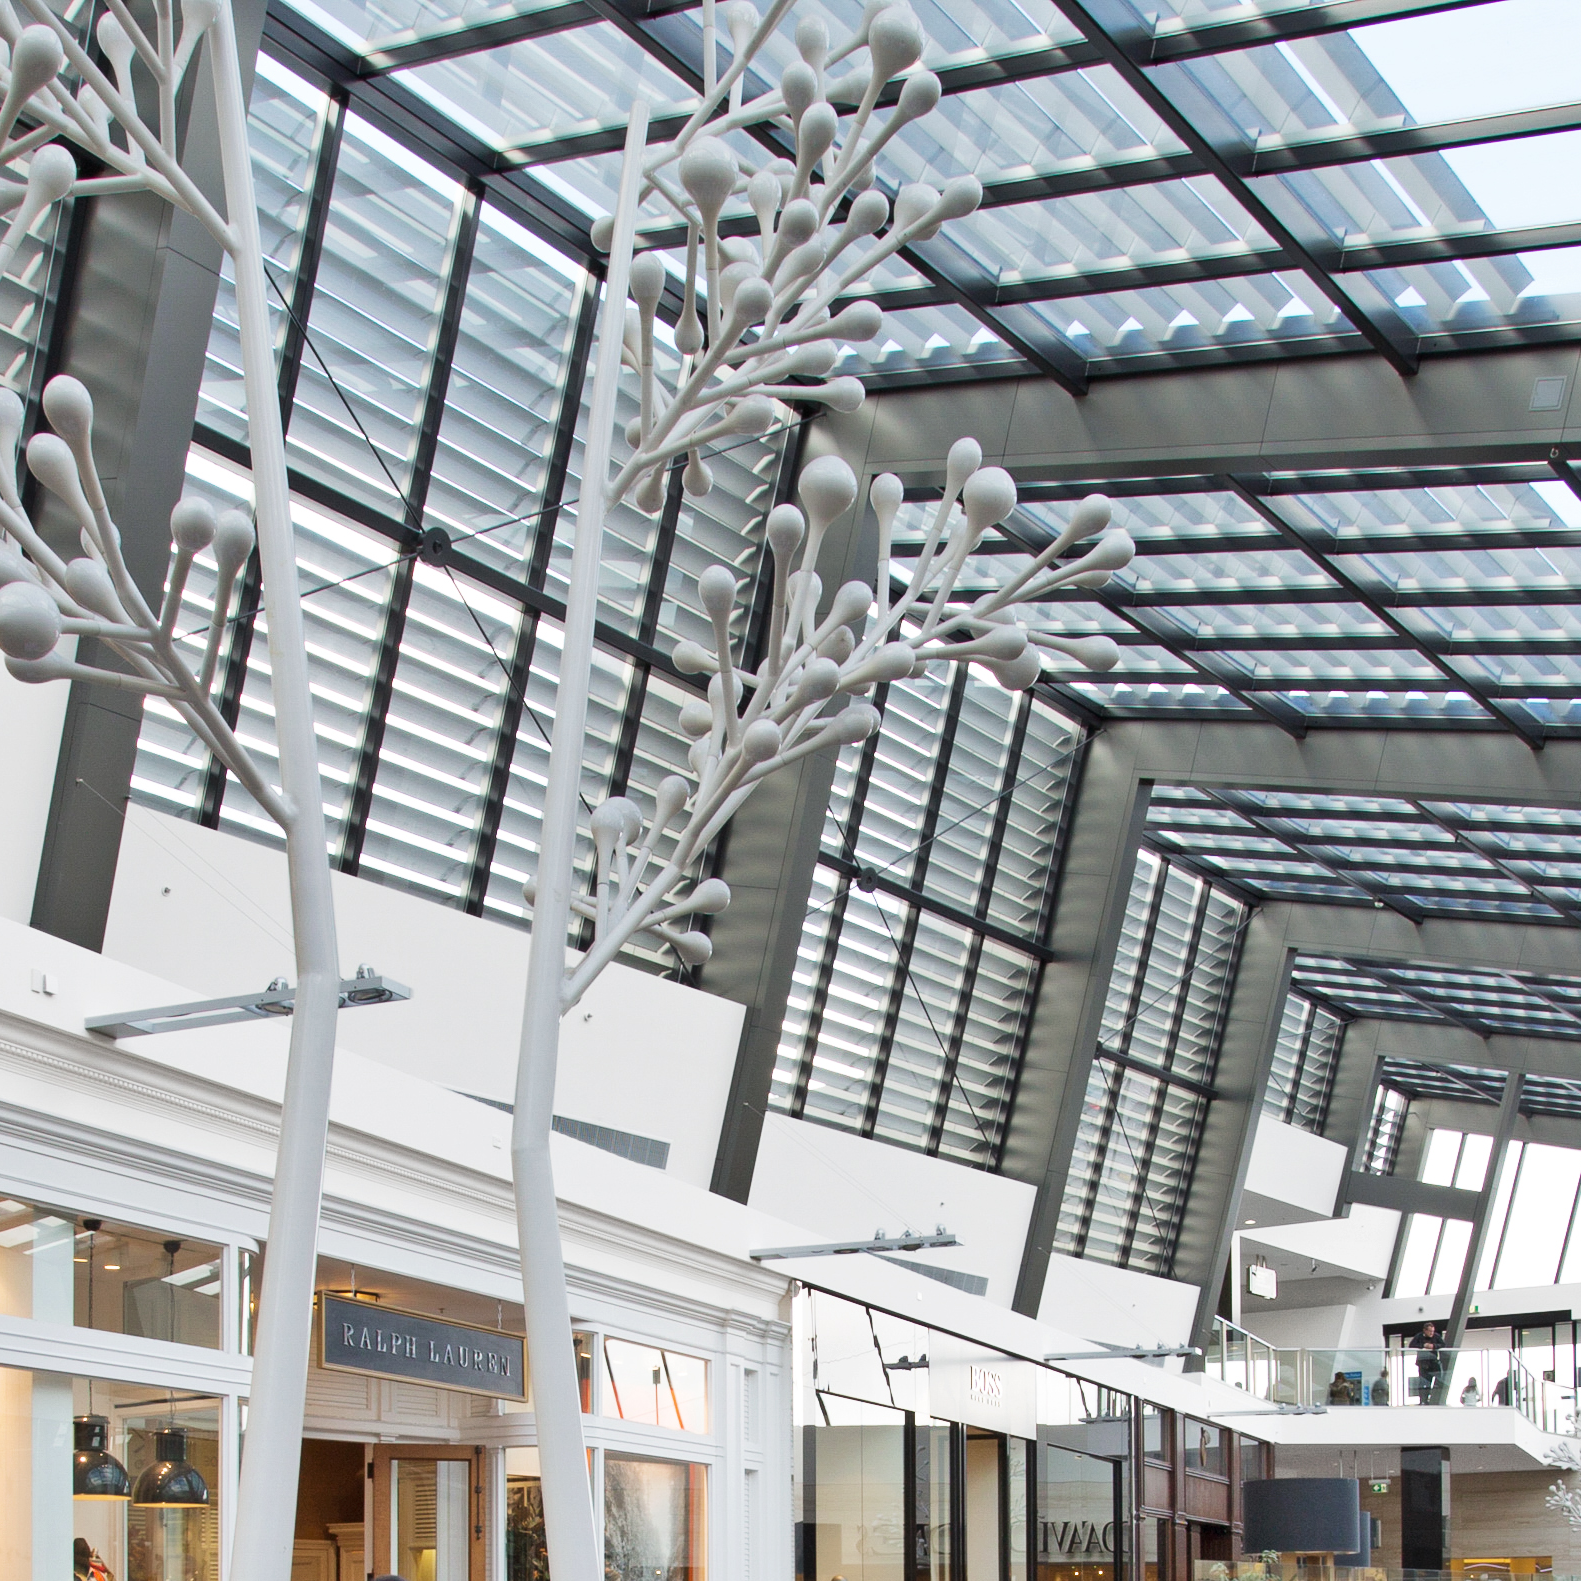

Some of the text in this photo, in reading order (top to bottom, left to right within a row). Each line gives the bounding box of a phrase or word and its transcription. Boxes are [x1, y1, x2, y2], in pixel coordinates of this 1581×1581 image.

[342, 1322, 511, 1377] RALPH LAUREN
[970, 1365, 1002, 1398] BOSS
